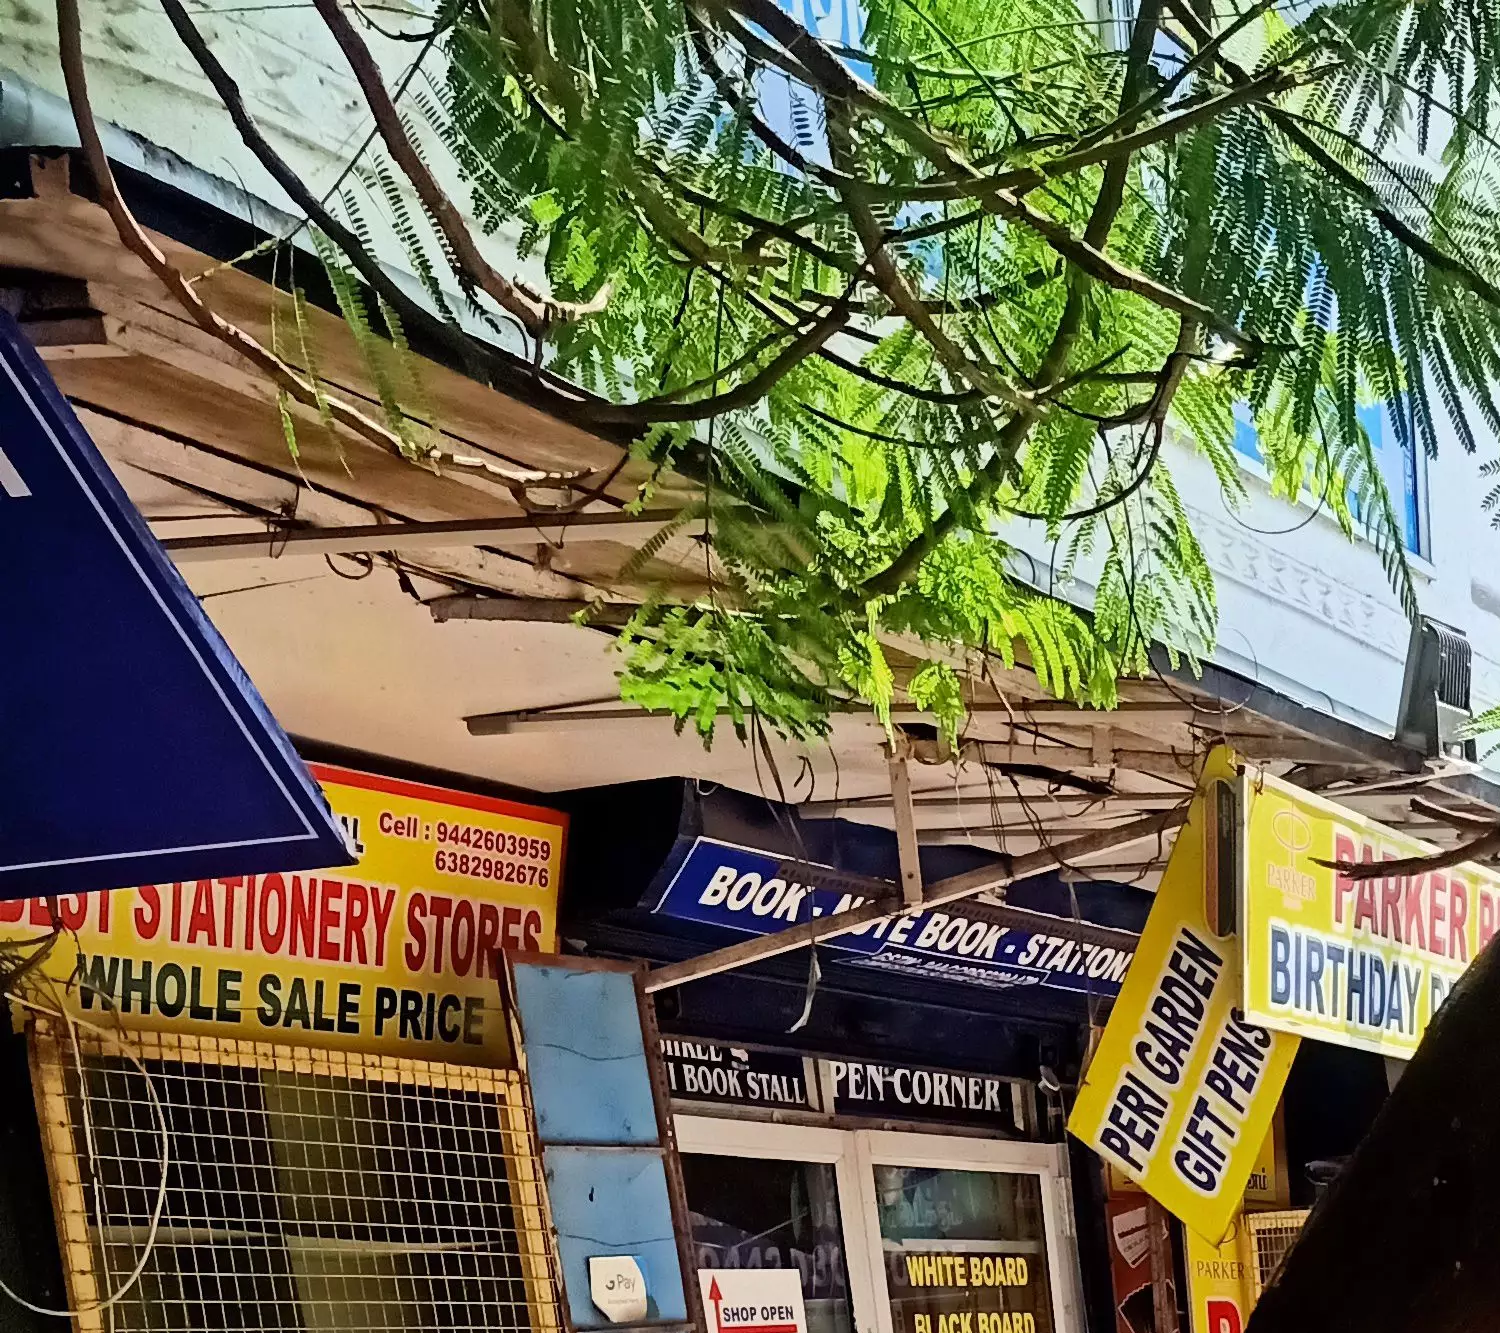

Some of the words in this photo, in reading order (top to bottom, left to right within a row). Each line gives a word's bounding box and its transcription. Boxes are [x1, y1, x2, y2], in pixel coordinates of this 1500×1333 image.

[379, 812, 418, 839] Cell
[436, 821, 551, 863] 9442603959
[435, 850, 549, 888] 6382982676
[1266, 862, 1317, 901] PARKER
[1335, 831, 1469, 964] PARKER
[698, 864, 812, 922] BOOK
[916, 911, 1010, 962] BOOK
[1017, 933, 1128, 983] STATION
[76, 953, 243, 1024] WHOLE
[256, 972, 363, 1036] SALE
[374, 985, 485, 1046] PRICE
[1270, 924, 1423, 1036] BIRTHDAY
[1099, 1070, 1170, 1173] PERI
[1135, 926, 1225, 1086] GARDEN
[1204, 1006, 1273, 1115] PENS
[683, 1062, 744, 1099] BOOK
[747, 1071, 806, 1105] STALL
[893, 1068, 1003, 1112] CORNER
[1173, 1095, 1237, 1193] GIFT
[905, 1255, 968, 1287] WHITE
[969, 1256, 1029, 1287] BOARD
[1195, 1258, 1246, 1282] PARKER
[722, 1306, 757, 1323] SHOP
[760, 1305, 794, 1321] OPEN
